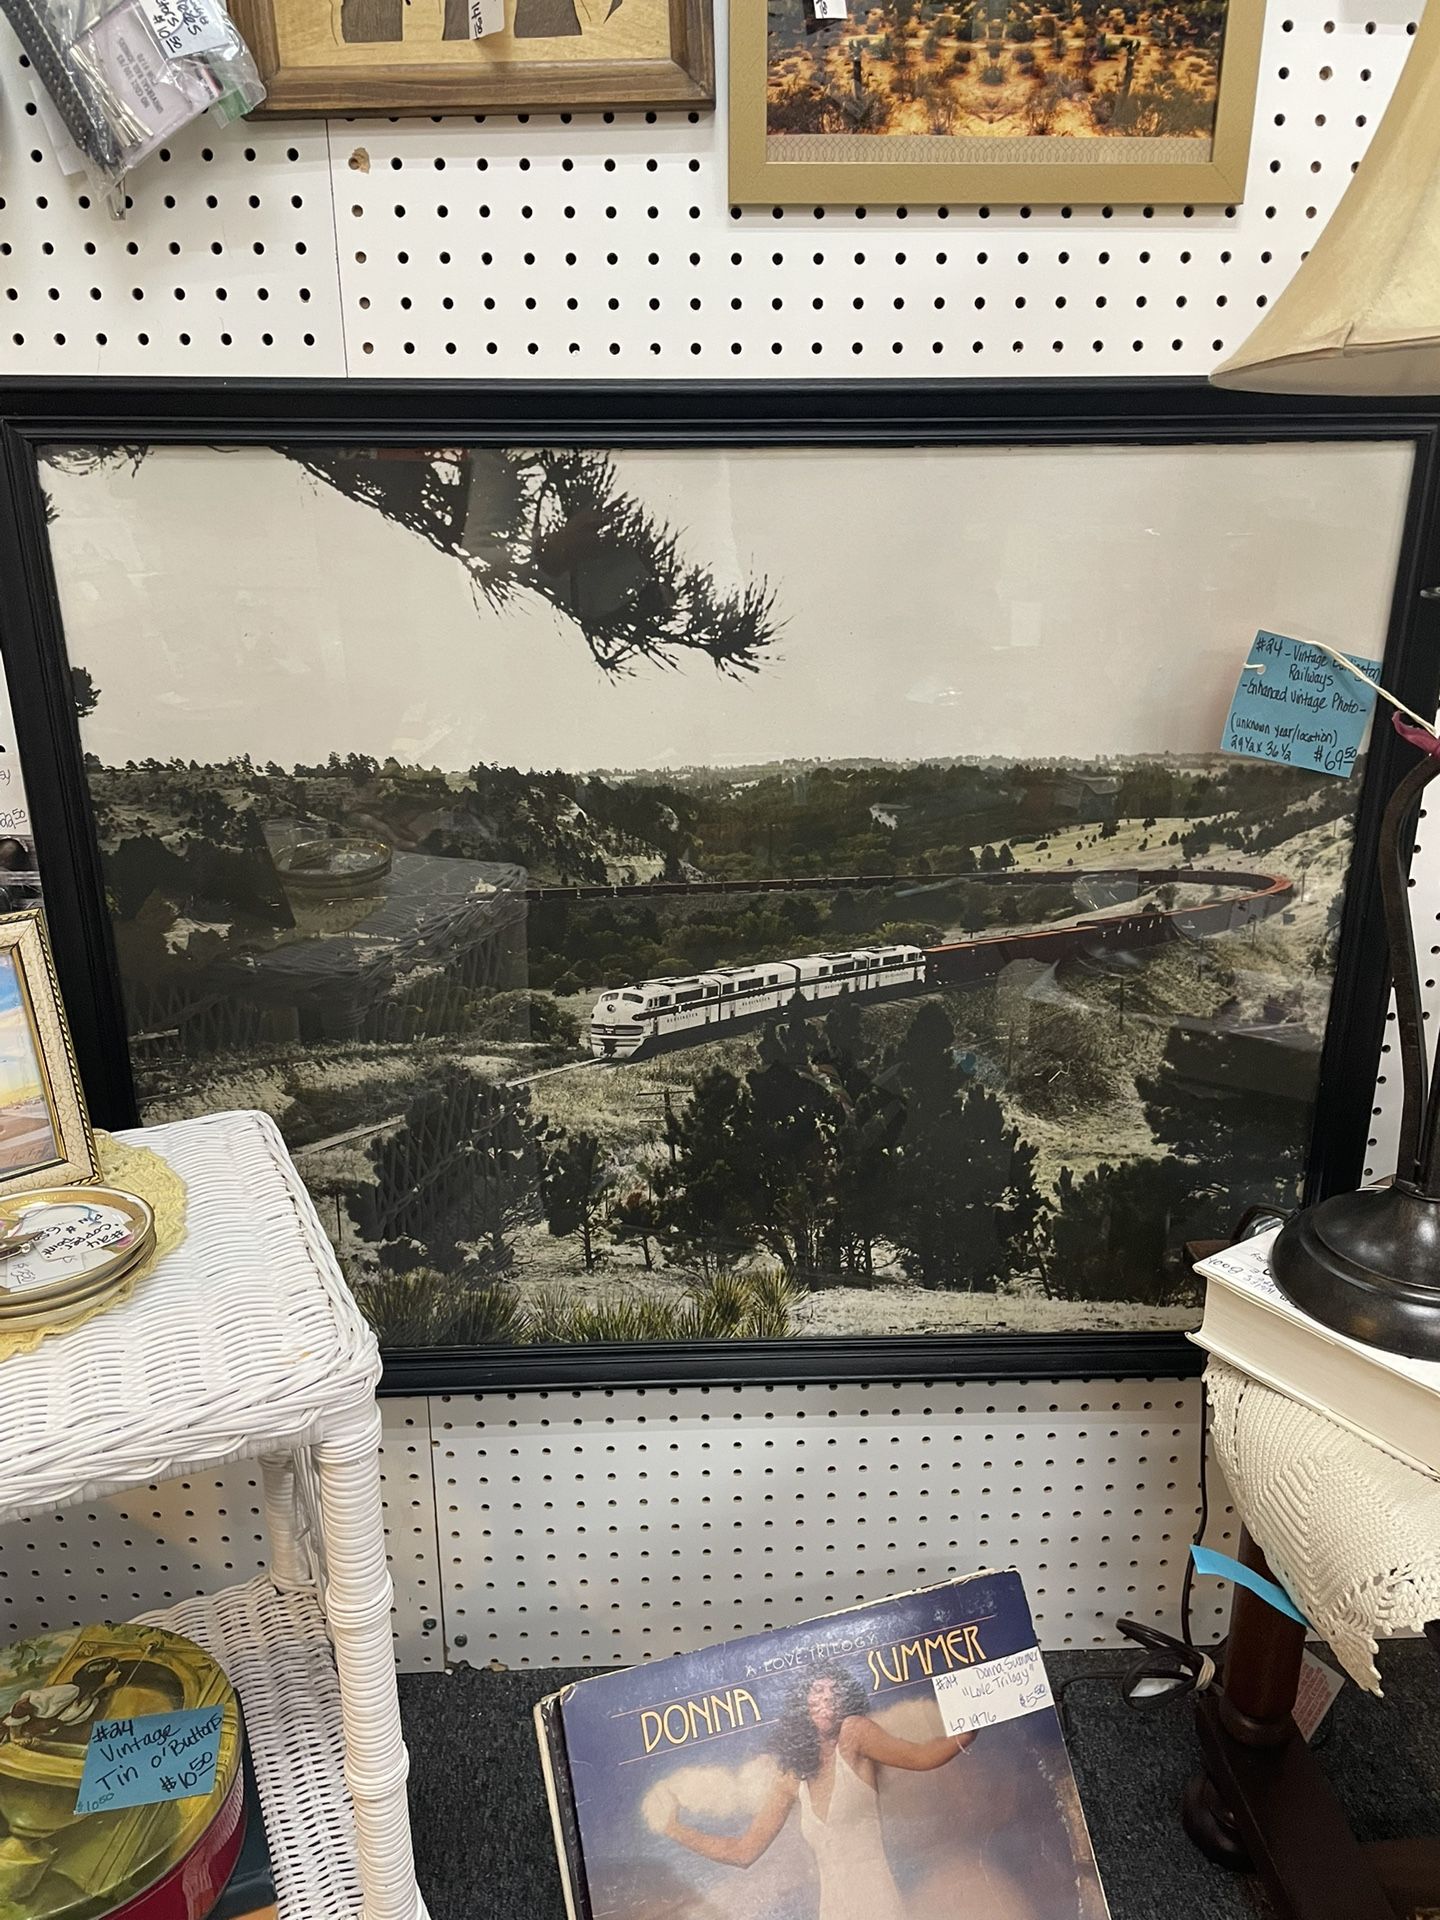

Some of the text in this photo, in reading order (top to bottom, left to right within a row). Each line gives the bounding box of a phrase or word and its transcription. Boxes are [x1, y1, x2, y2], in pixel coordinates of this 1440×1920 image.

[1256, 637, 1283, 658] #24
[1293, 645, 1328, 671] Vintage
[1289, 664, 1334, 692] Railways
[640, 1624, 987, 1754] DONNA SUMMER
[91, 1719, 135, 1744] #24
[950, 1711, 998, 1732] LP 1976
[100, 1724, 181, 1763] Vintage
[95, 1765, 139, 1792] Tin
